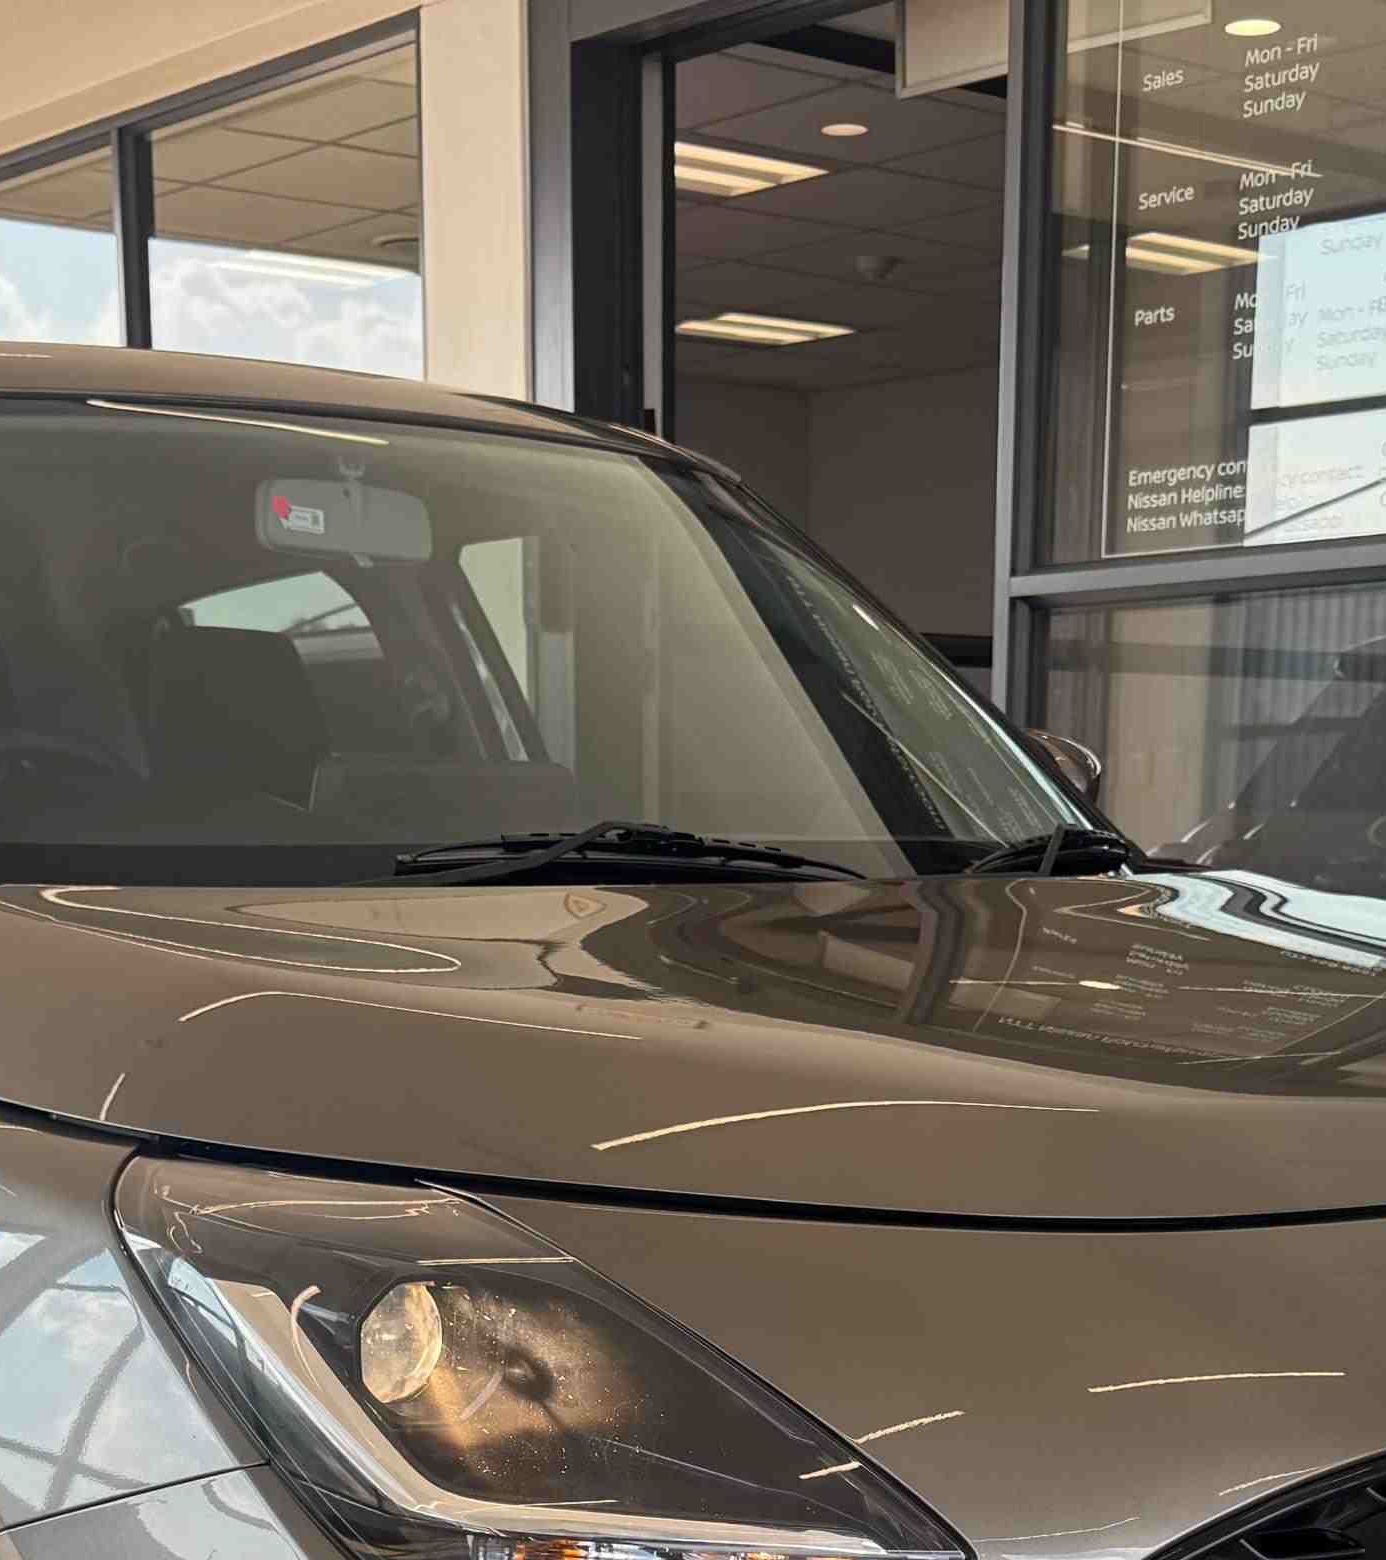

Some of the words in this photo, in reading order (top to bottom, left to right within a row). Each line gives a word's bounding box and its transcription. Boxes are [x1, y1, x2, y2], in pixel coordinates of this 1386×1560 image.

[1245, 46, 1282, 67] Mon
[1297, 33, 1318, 55] Fri
[1142, 69, 1184, 92] Sales
[1245, 62, 1320, 93] Saturday
[1243, 91, 1307, 118] Sunday
[1240, 168, 1276, 190] Mon
[1291, 160, 1313, 179] Fri
[1138, 186, 1195, 211] Service
[1239, 188, 1315, 216] Saturday
[1238, 215, 1301, 240] Sunday
[1135, 306, 1175, 327] Parts
[1129, 463, 1214, 487] Emergency
[1128, 491, 1177, 510] Nissan
[1180, 484, 1246, 506] Helpline
[1127, 515, 1176, 533] Nissan
[1179, 509, 1246, 527] Whatsap
